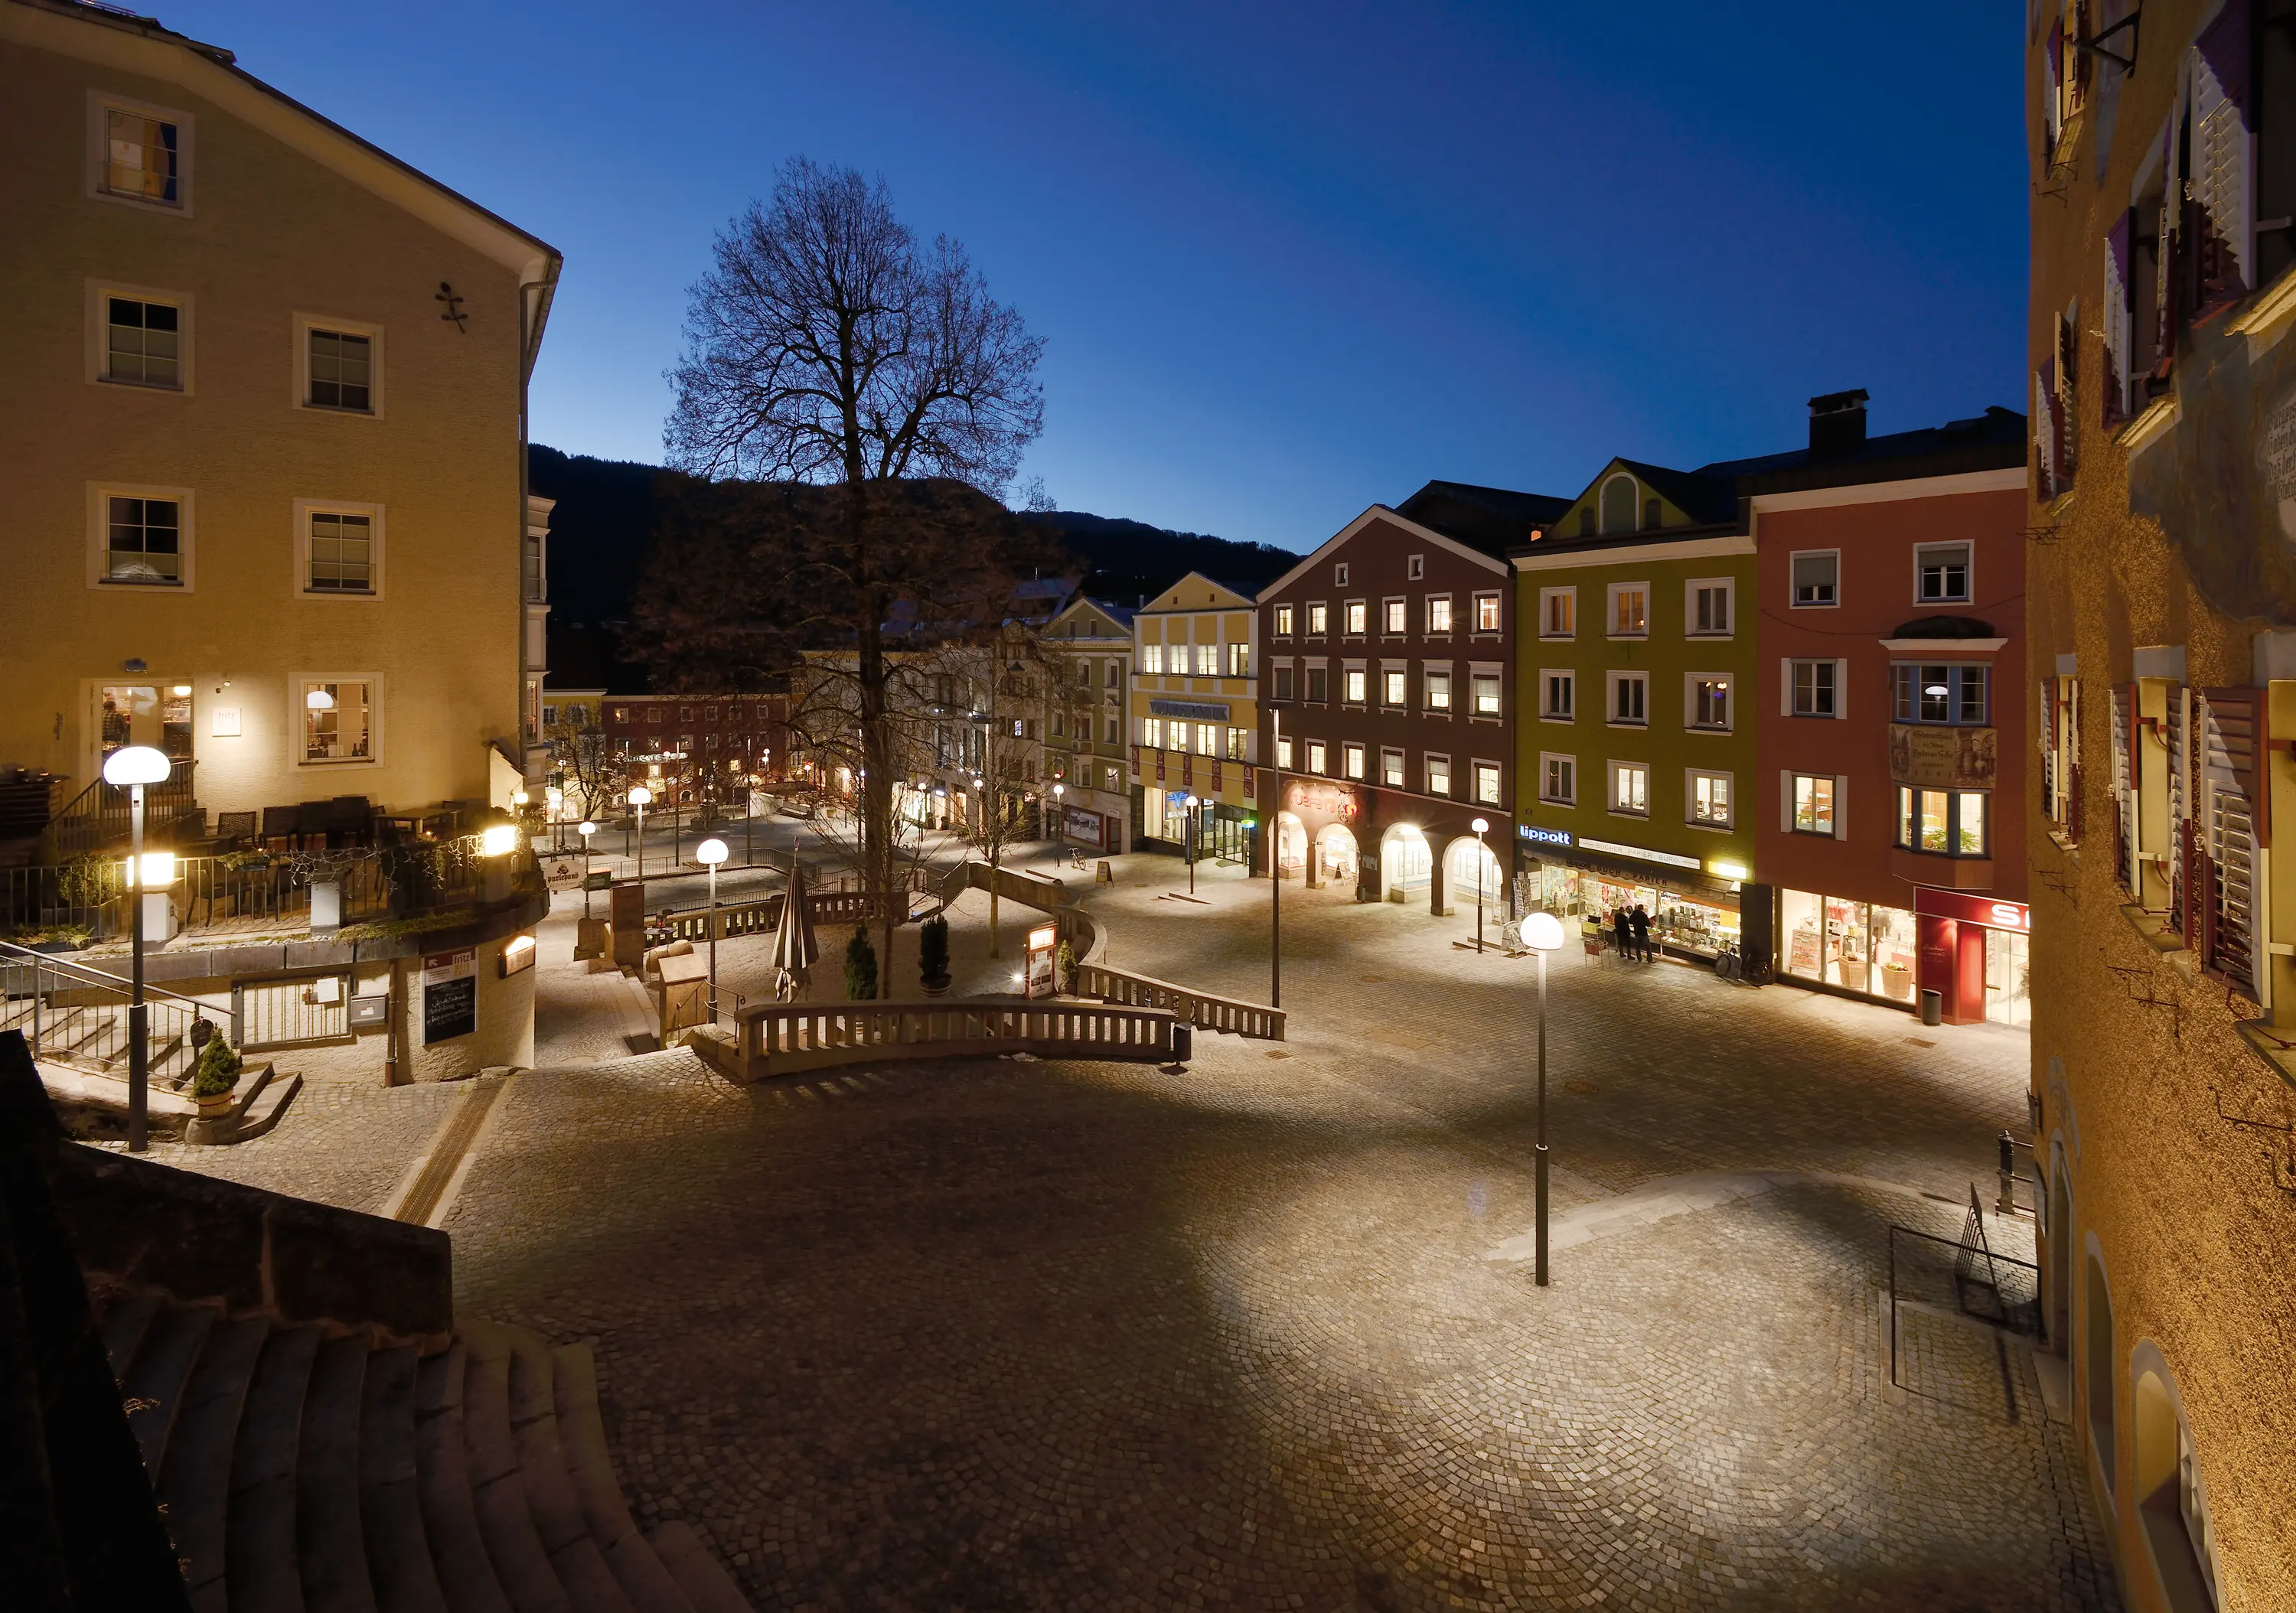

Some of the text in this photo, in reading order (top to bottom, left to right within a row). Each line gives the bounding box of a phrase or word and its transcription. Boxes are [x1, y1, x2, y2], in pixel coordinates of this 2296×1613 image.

[218, 712, 235, 720] fritz
[1167, 810, 1189, 819] BANK
[1519, 825, 1570, 845] lippott
[1628, 849, 1652, 859] PAPIER
[1597, 865, 1621, 876] BUCH
[1632, 873, 1668, 886] PAPIER
[1991, 904, 2030, 928] S
[454, 954, 470, 965] fritz
